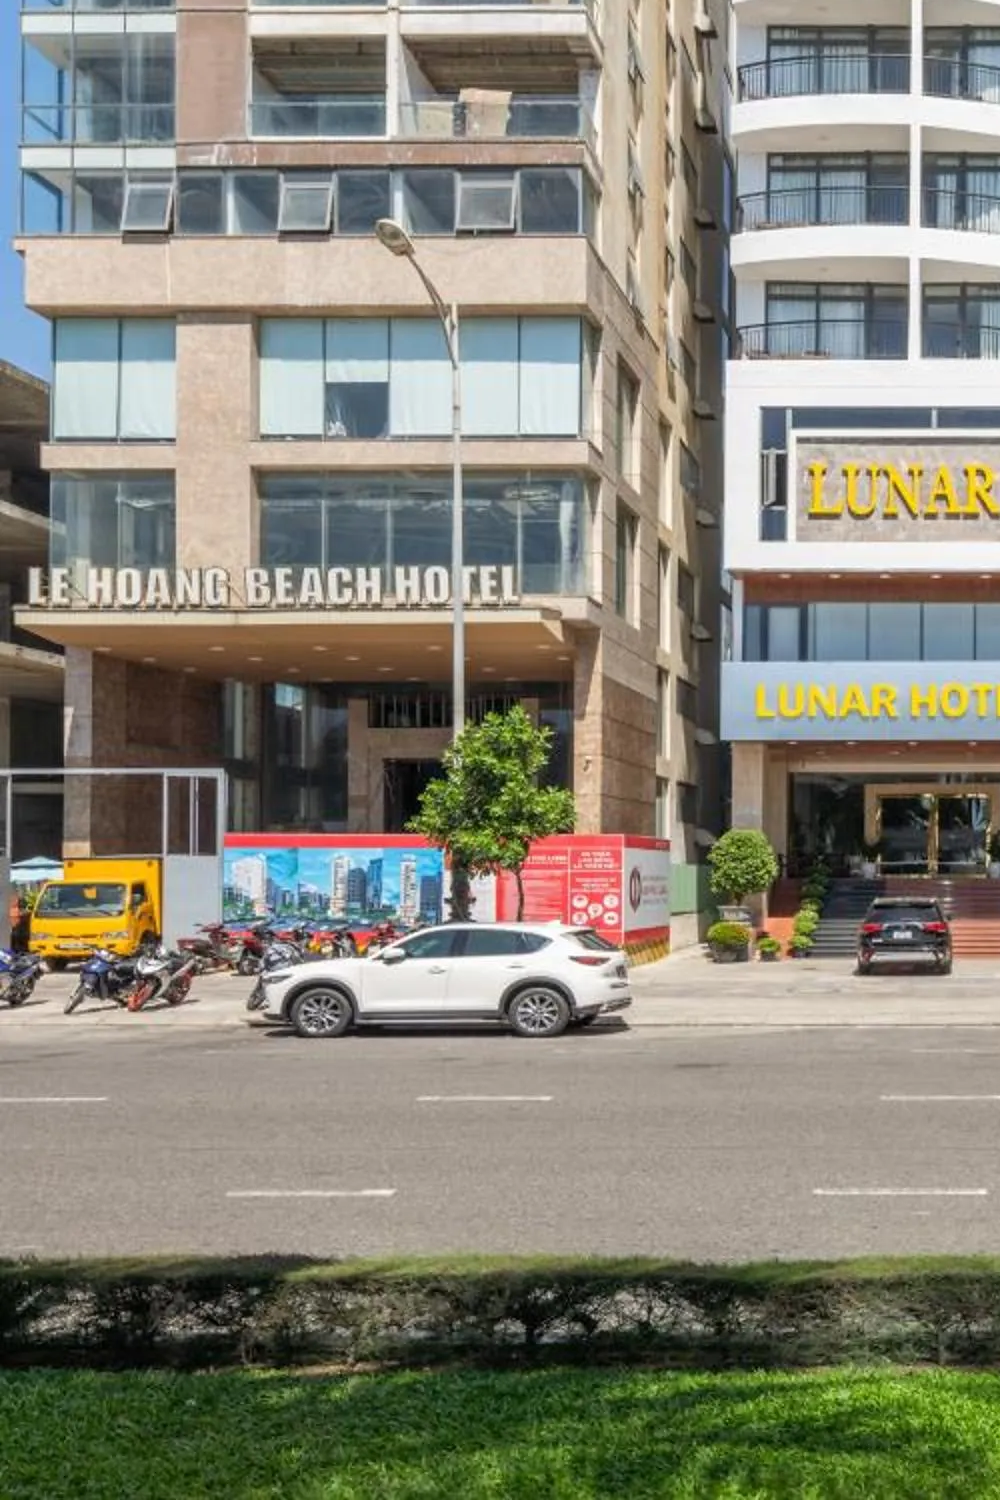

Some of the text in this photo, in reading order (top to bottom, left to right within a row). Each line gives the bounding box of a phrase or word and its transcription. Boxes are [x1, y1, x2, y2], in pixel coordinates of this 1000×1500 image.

[808, 462, 999, 518] LUNAR
[28, 565, 521, 607] LE HOANG BEACH HOTEL
[755, 683, 897, 719] LUNAR
